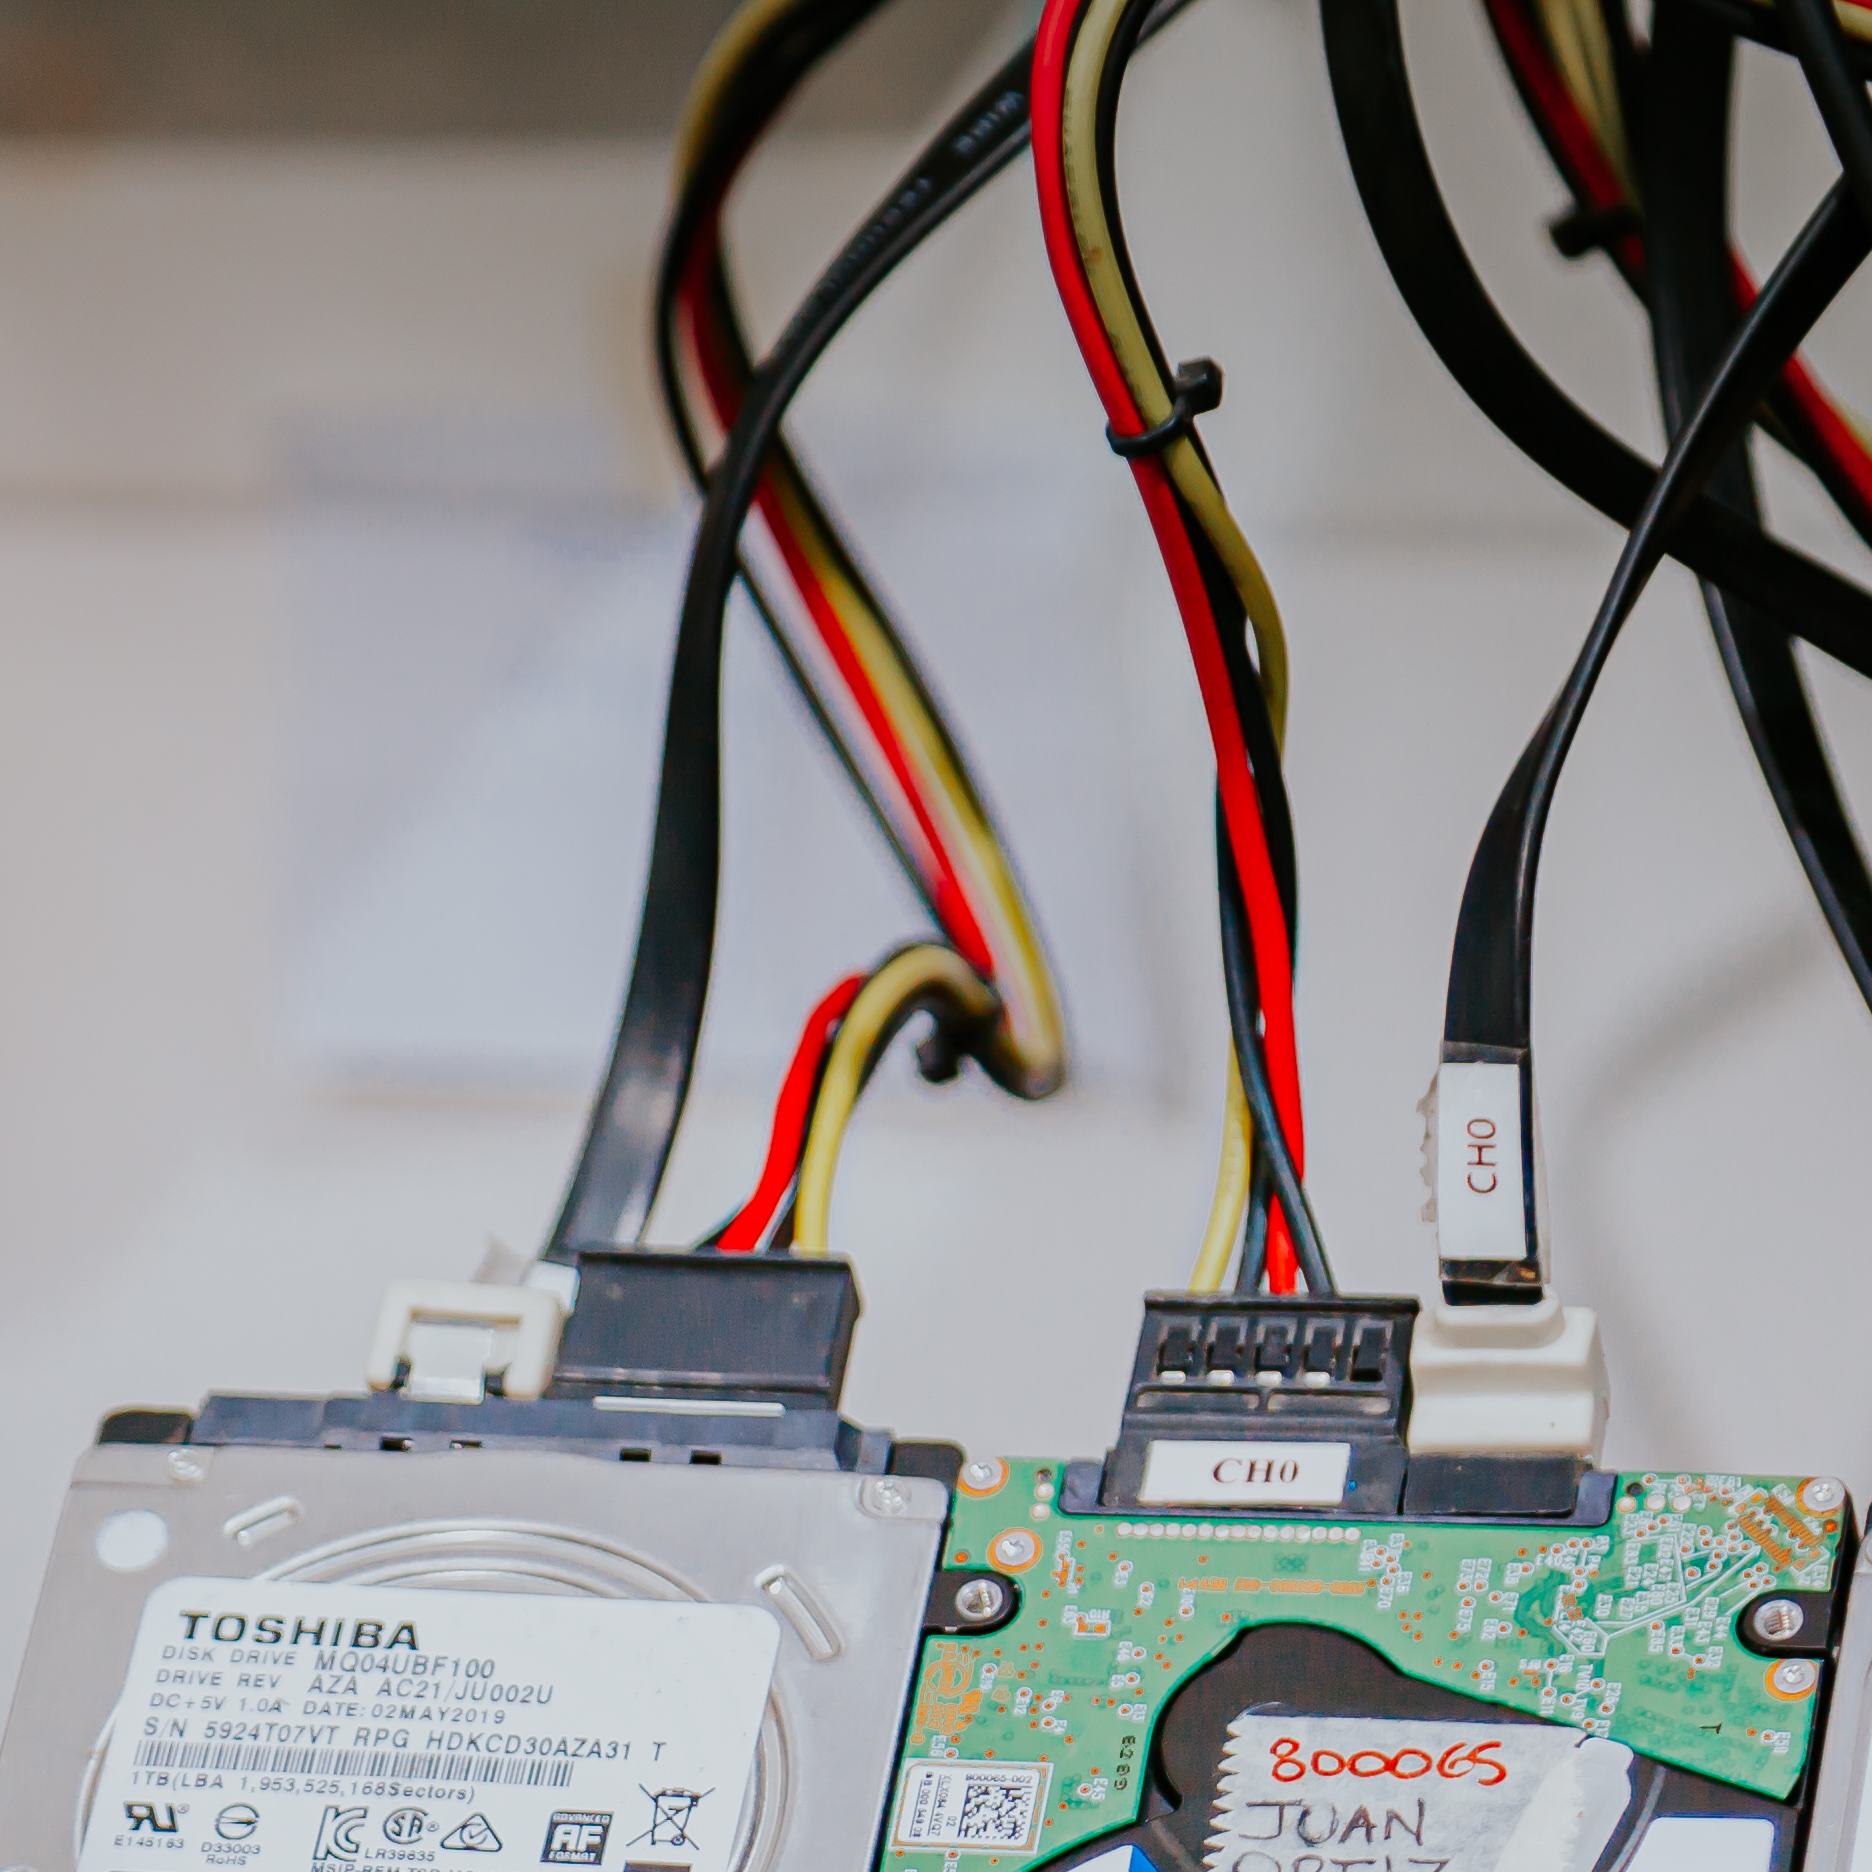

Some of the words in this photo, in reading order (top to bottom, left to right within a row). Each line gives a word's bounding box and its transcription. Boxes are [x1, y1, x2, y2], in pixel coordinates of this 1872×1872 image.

[1466, 1118, 1498, 1194] CH0
[1212, 1457, 1300, 1485] CH0
[173, 1610, 425, 1651] TOSHIBA
[161, 1644, 217, 1662] DISK
[229, 1648, 297, 1666] DRIVE
[313, 1649, 497, 1680] MQ04UBF100
[155, 1668, 224, 1686] DRIVE
[236, 1672, 281, 1689] REV
[306, 1673, 362, 1695] AZA
[375, 1676, 554, 1706] AC21/JU002U
[237, 1696, 291, 1714] 1.0A
[142, 1716, 188, 1738] S/N
[203, 1719, 340, 1746] 5924T07VT
[352, 1726, 411, 1749] RPG
[425, 1729, 631, 1760] HDKCD30AZA31
[648, 1741, 667, 1761] T
[129, 1769, 226, 1793] 1TB(LBA
[1269, 1737, 1507, 1786] 800065
[1238, 1798, 1425, 1847] JUAN
